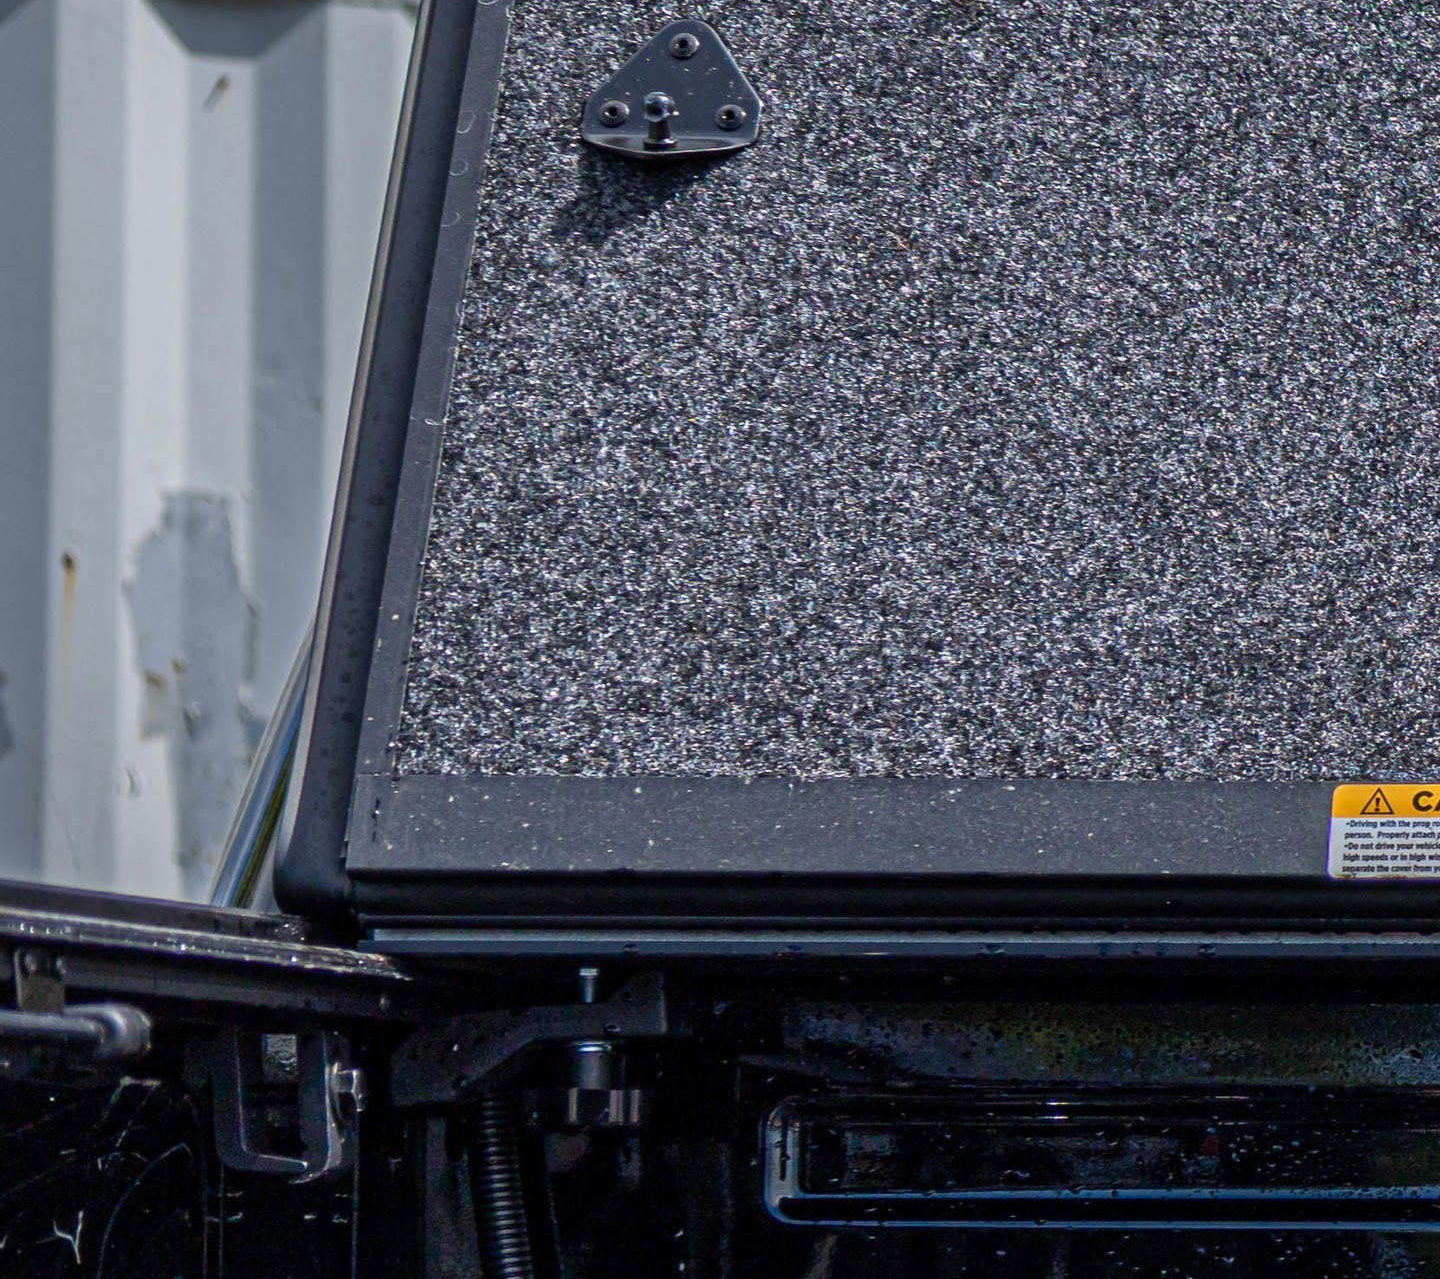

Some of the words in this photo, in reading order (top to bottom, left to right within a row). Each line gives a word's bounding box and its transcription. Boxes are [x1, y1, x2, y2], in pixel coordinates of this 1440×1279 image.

[1413, 820, 1430, 829] prop
[1377, 831, 1409, 839] Properly
[1343, 854, 1360, 862] high
[1362, 854, 1388, 862] speeds
[1409, 854, 1426, 862] high
[1342, 865, 1375, 873] separate
